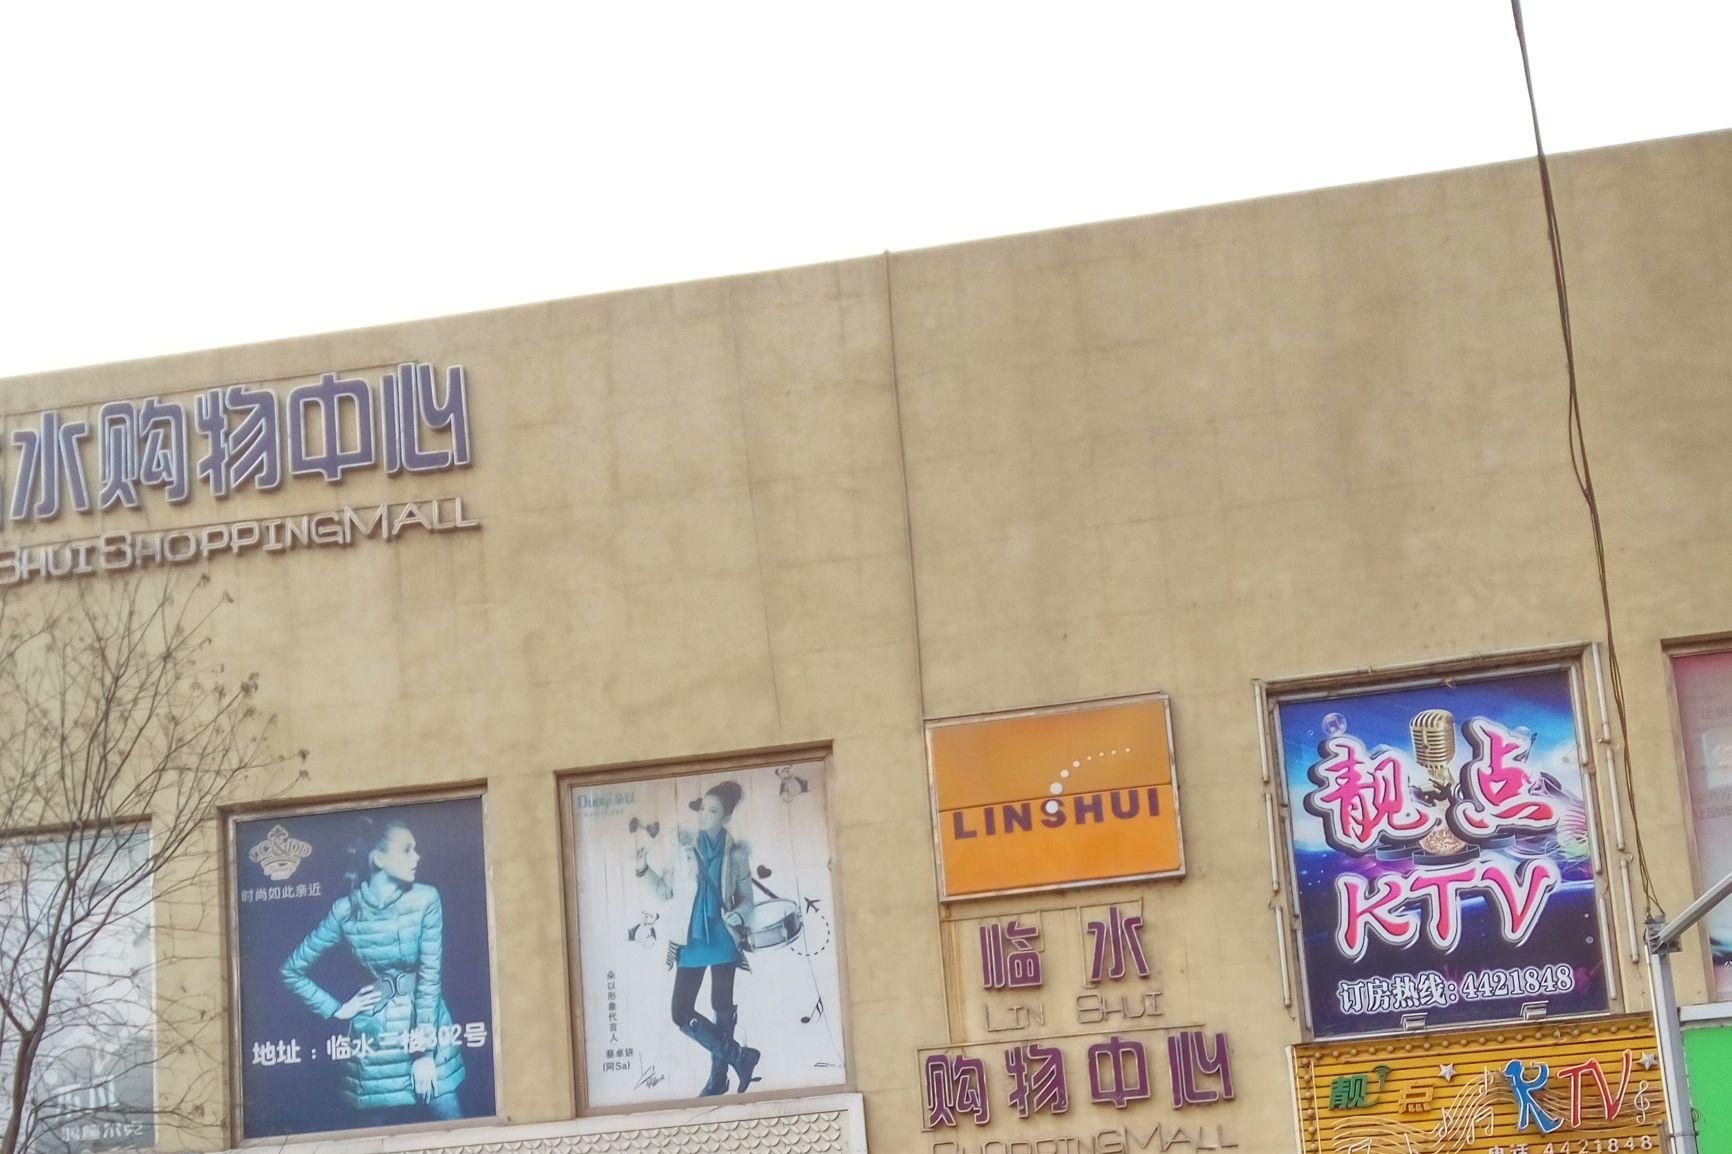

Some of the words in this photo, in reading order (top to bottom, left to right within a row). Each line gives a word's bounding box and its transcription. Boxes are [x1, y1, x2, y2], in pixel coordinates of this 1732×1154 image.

[9, 362, 471, 521] 水购物中心
[953, 786, 1160, 840] LINSHUI
[1304, 716, 1561, 858] 靓点
[241, 882, 322, 902] 时尚如此亲近
[1335, 858, 1563, 960] KTV
[978, 906, 1150, 991] 临水
[925, 1030, 1236, 1129] 购物中心
[1329, 1065, 1434, 1114] 靓点
[1504, 1049, 1633, 1134] KTV
